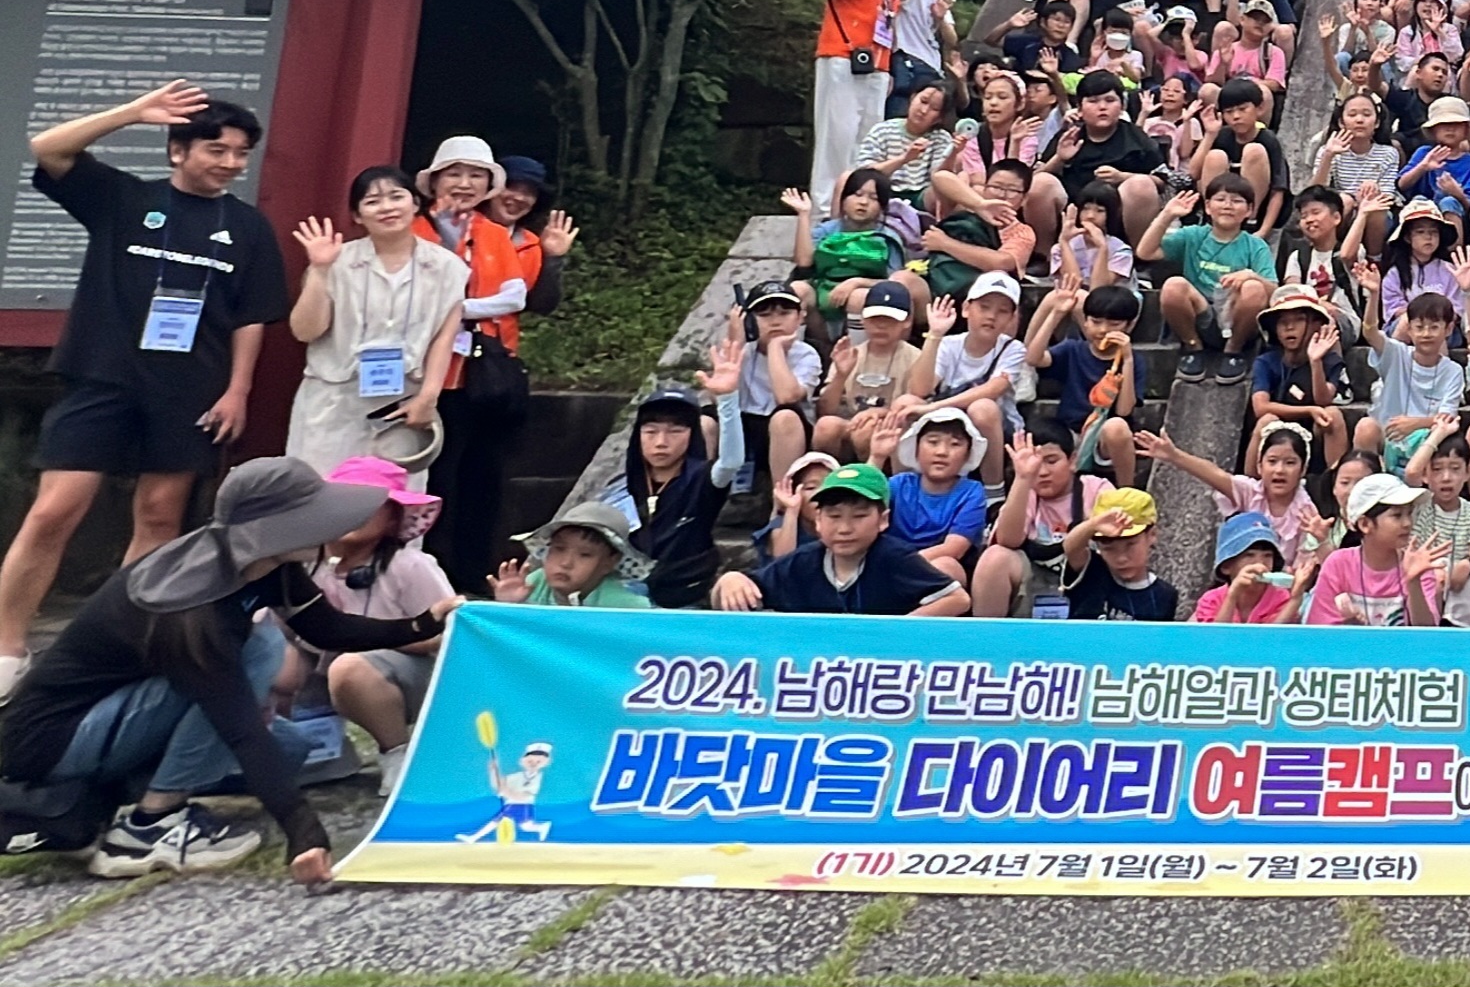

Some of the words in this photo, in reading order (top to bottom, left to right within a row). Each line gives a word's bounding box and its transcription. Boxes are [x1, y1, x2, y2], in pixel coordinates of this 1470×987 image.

[628, 658, 763, 710] 2024.
[776, 660, 921, 716] 남해랑
[927, 662, 1081, 719] 만남해!
[1093, 665, 1276, 723] 남해얼과
[1283, 669, 1461, 724] 생태체험
[596, 730, 892, 816] 바닷마을
[898, 739, 1178, 817] 다이어리
[815, 850, 896, 877] (1기)
[900, 852, 1030, 878] 2024년
[1036, 854, 1092, 879] 7월
[1100, 855, 1207, 880] 1일(월)
[1247, 855, 1301, 879] 7월
[1306, 855, 1419, 880] 2일(화)
